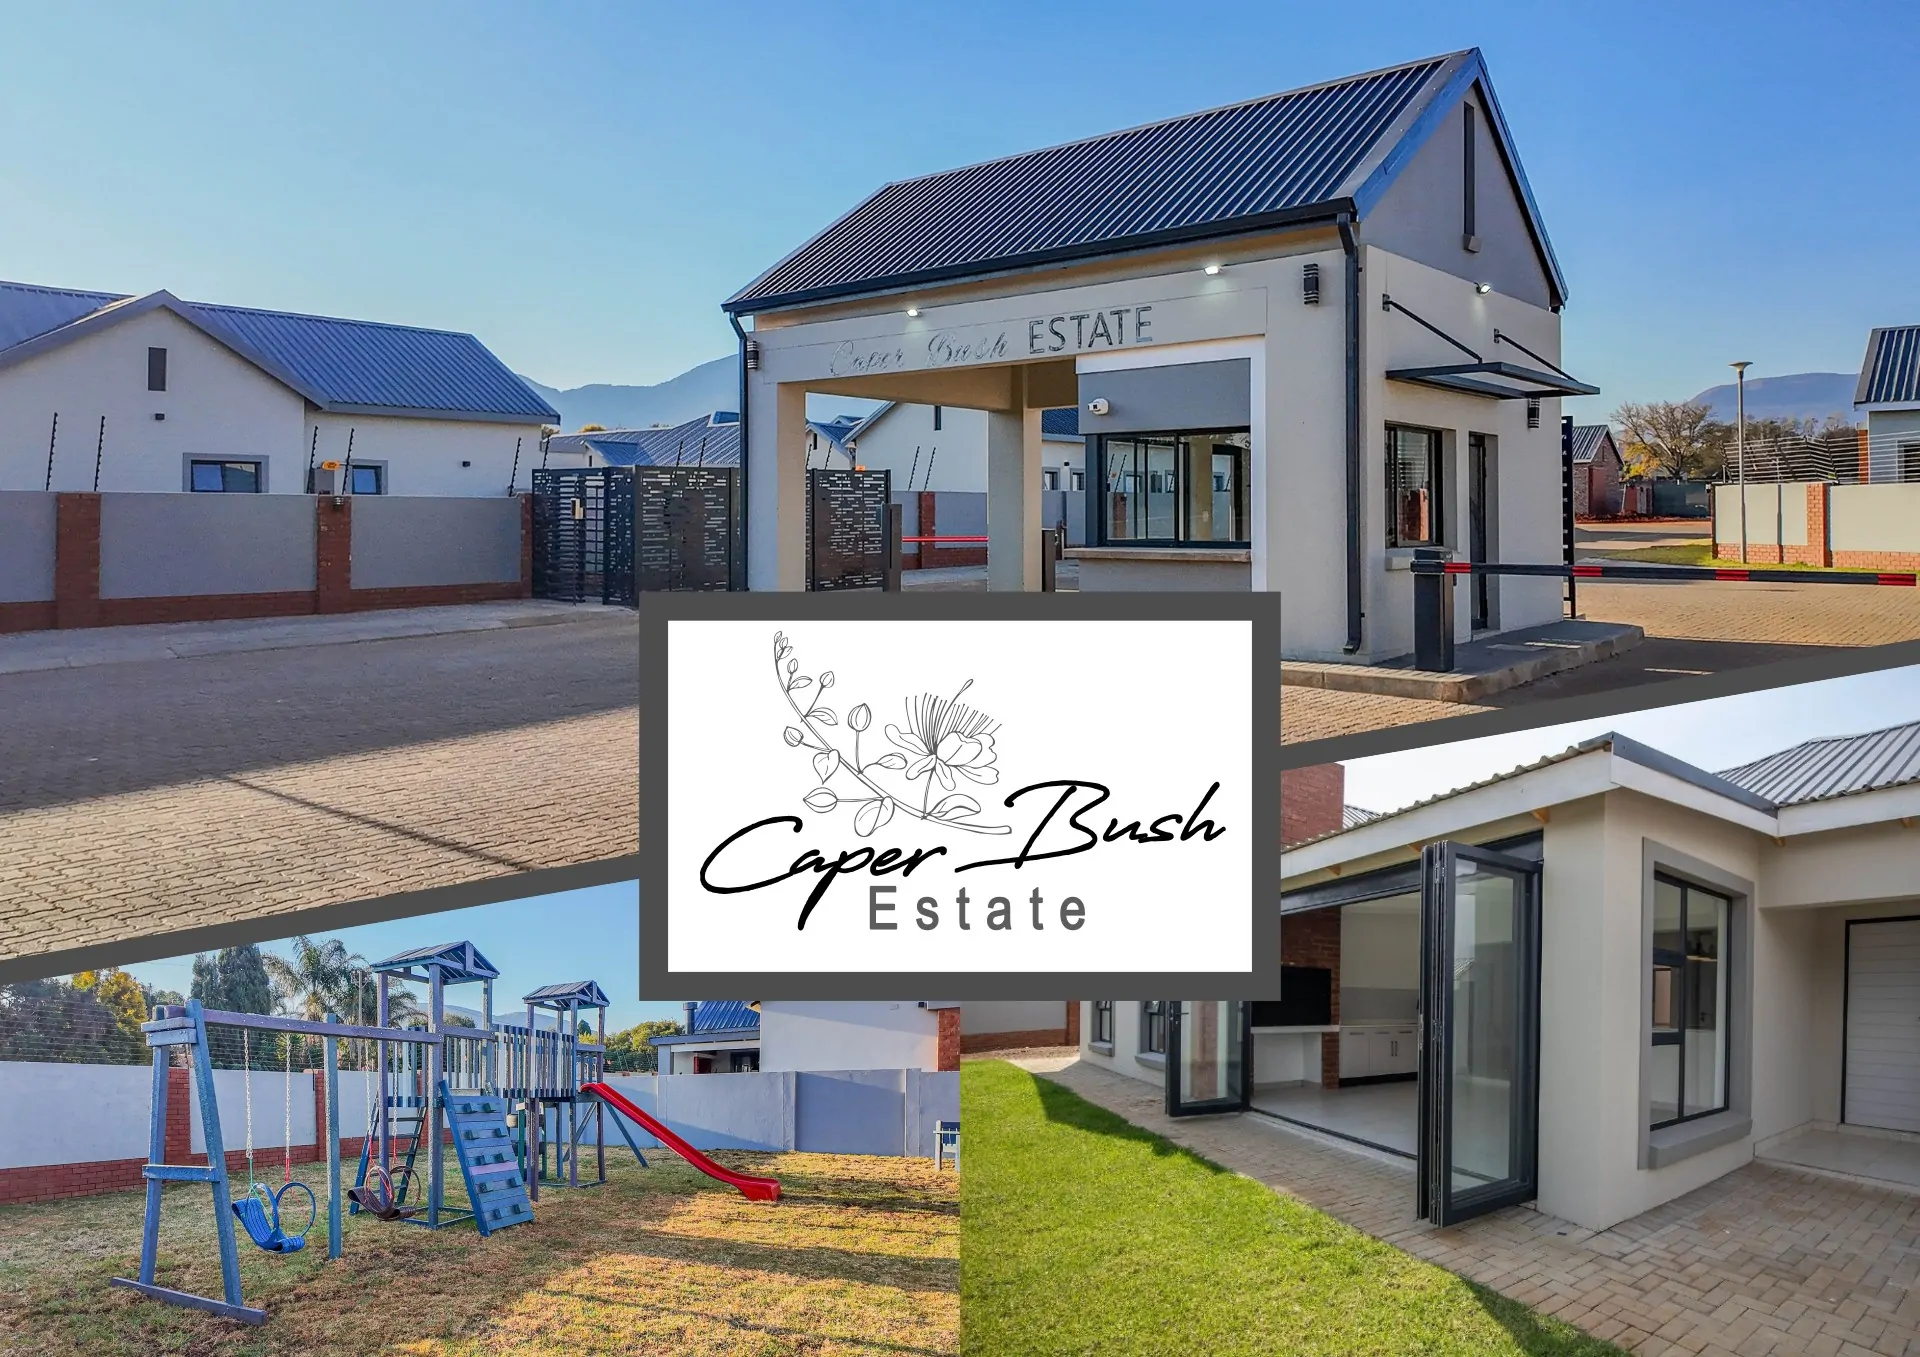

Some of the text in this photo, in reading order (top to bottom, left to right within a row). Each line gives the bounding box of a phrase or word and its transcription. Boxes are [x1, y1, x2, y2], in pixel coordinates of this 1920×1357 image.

[829, 306, 1154, 377] Caper Bush ESTATE
